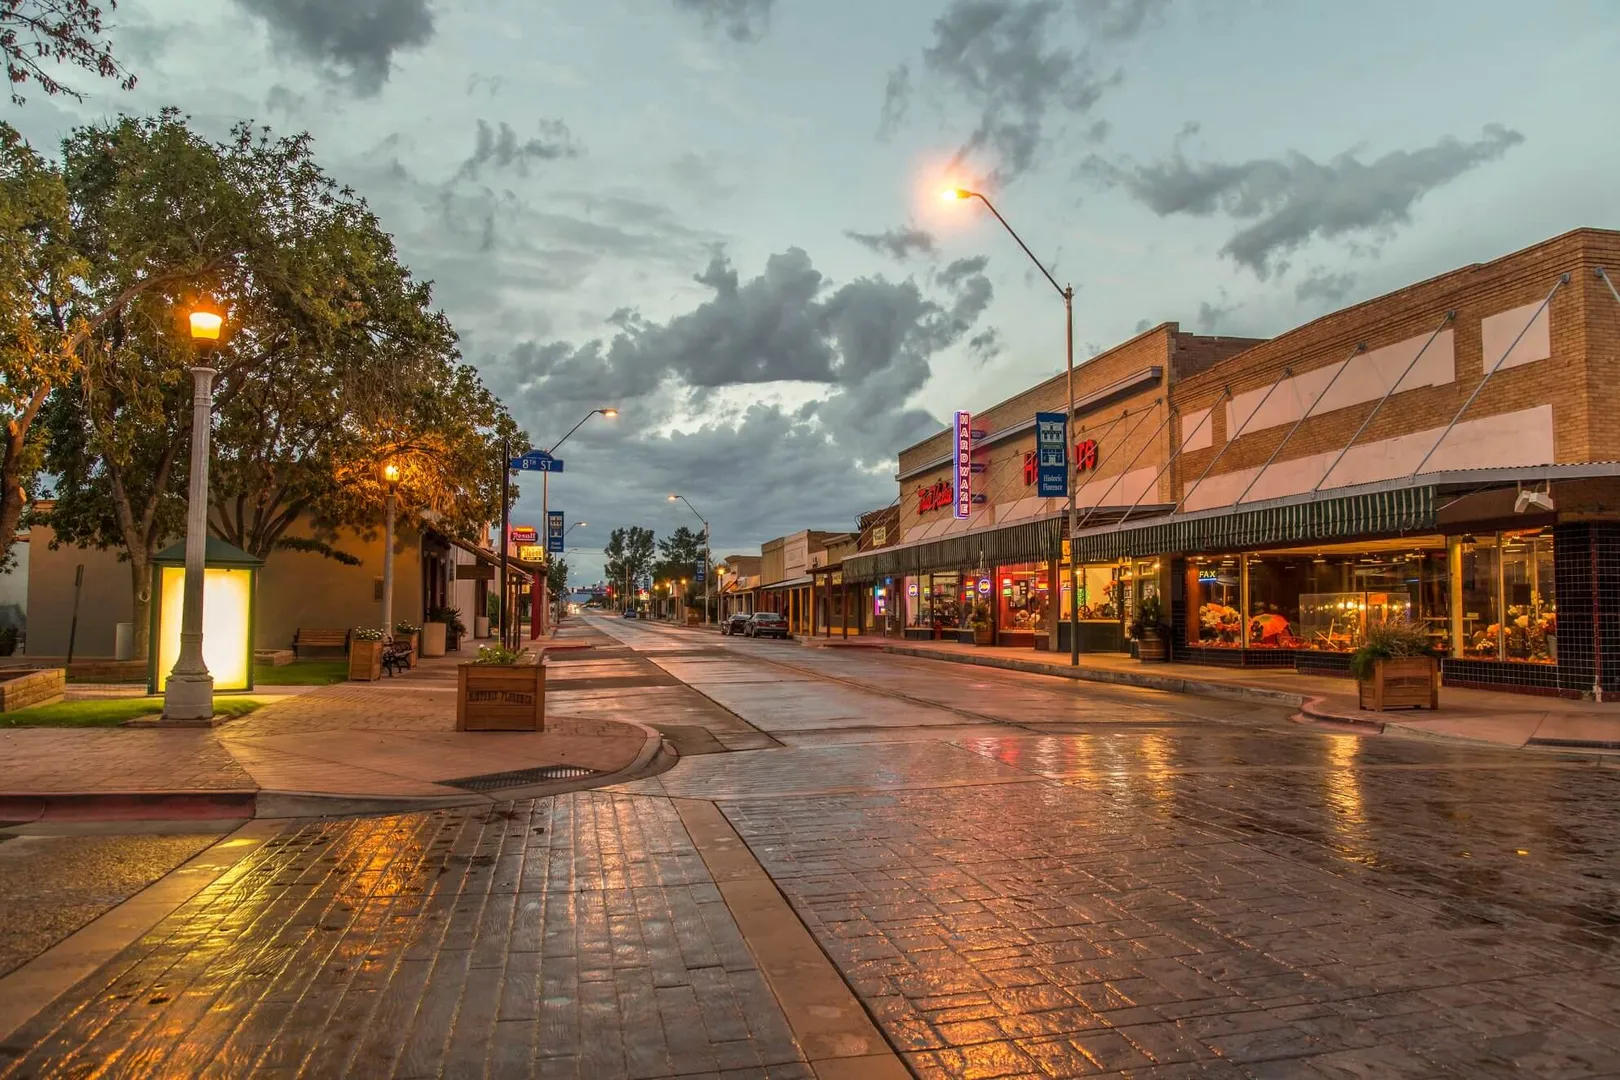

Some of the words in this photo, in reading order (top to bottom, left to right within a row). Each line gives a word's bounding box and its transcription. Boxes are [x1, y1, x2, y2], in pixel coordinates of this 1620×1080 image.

[522, 459, 536, 469] 8TH
[540, 460, 552, 470] ST
[960, 414, 969, 514] HARDWARE
[1043, 474, 1063, 482] Historic
[1043, 483, 1063, 491] Florence
[1199, 570, 1216, 578] FAX
